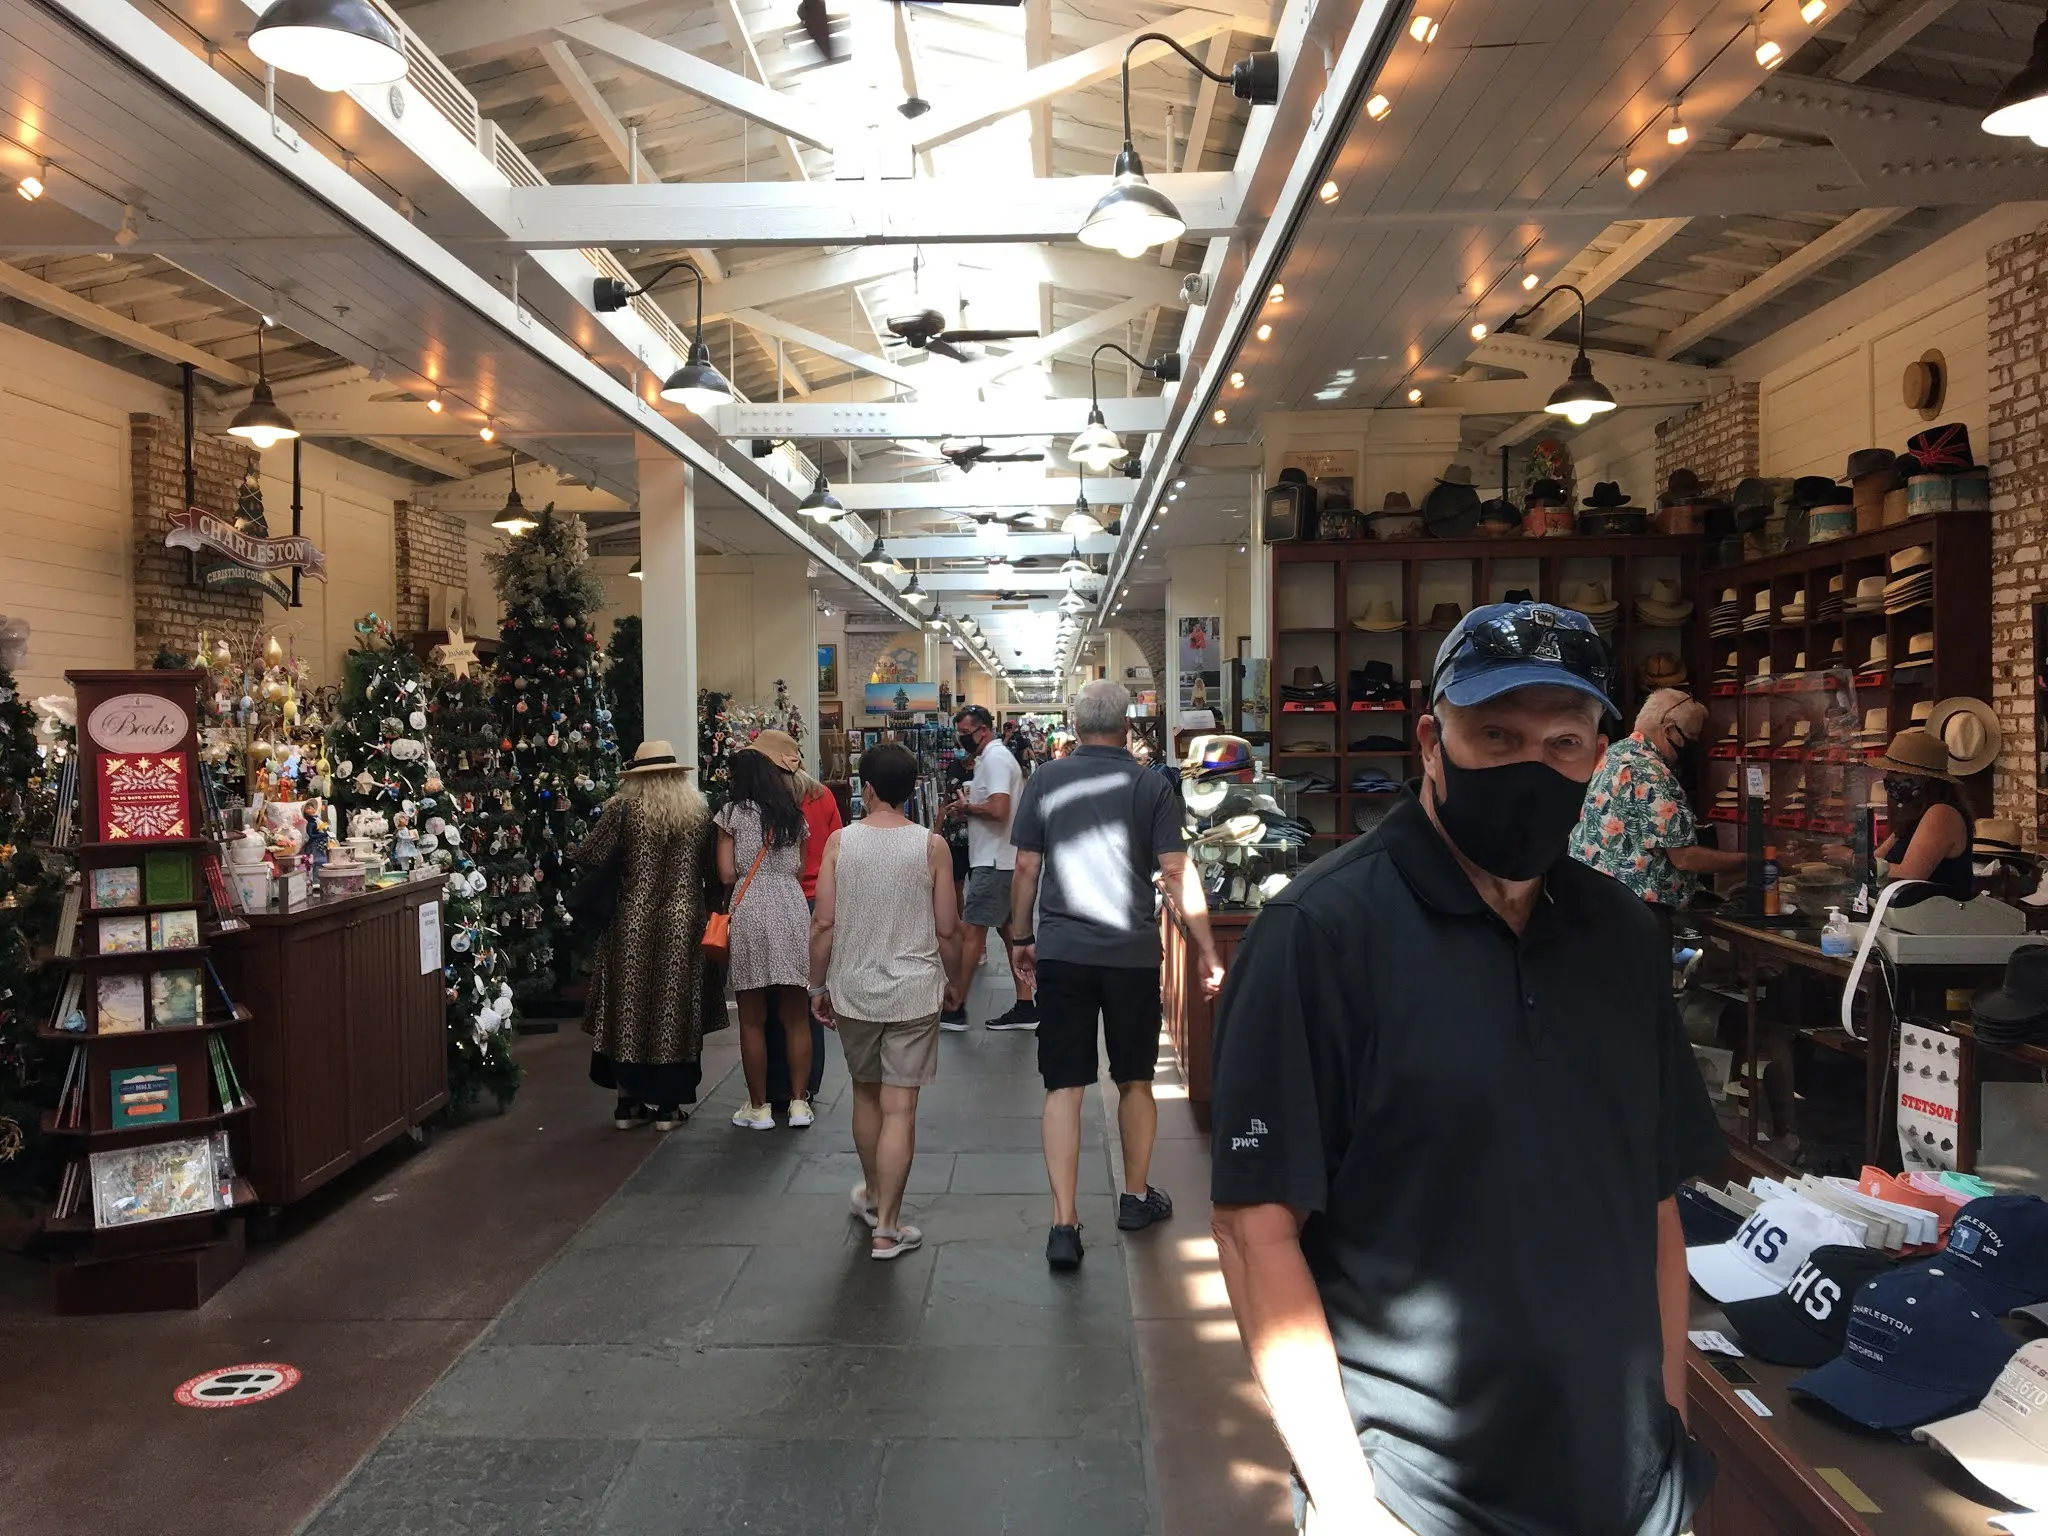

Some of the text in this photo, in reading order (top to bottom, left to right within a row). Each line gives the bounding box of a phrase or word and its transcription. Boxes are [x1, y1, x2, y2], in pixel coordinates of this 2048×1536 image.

[199, 516, 305, 563] CHARLESTON
[206, 567, 288, 602] CHRISTMAS COLCTIBLES
[1901, 1094, 1954, 1121] STETSON
[1231, 1137, 1260, 1151] pwc
[1981, 1245, 1998, 1257] 1670
[1787, 1258, 1842, 1321] HS
